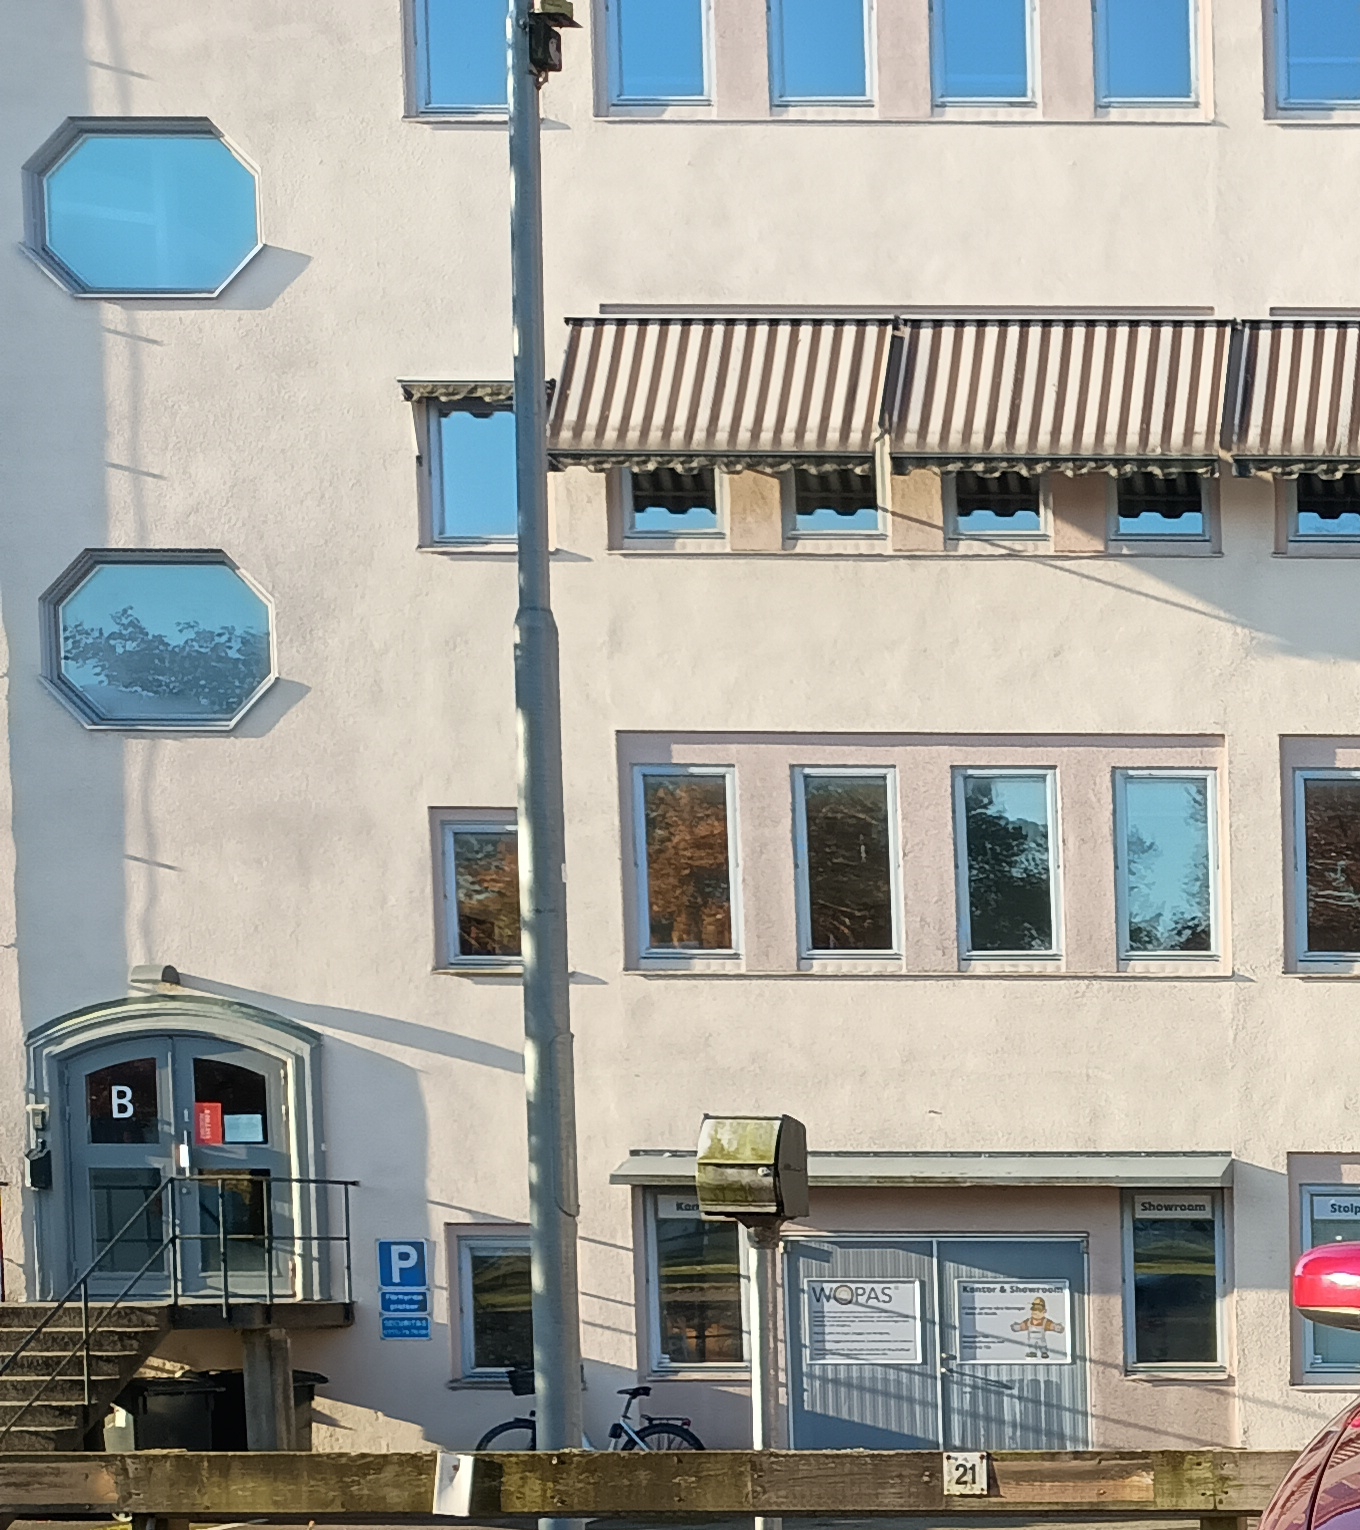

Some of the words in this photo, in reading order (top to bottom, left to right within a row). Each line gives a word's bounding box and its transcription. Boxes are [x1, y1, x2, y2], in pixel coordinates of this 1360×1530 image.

[112, 1085, 134, 1119] B
[675, 1202, 700, 1212] Kon
[1140, 1202, 1206, 1212] Showroom
[390, 1244, 418, 1283] P
[812, 1284, 893, 1305] WOPAS
[1009, 1285, 1064, 1294] Showroom
[955, 1463, 976, 1485] 21
